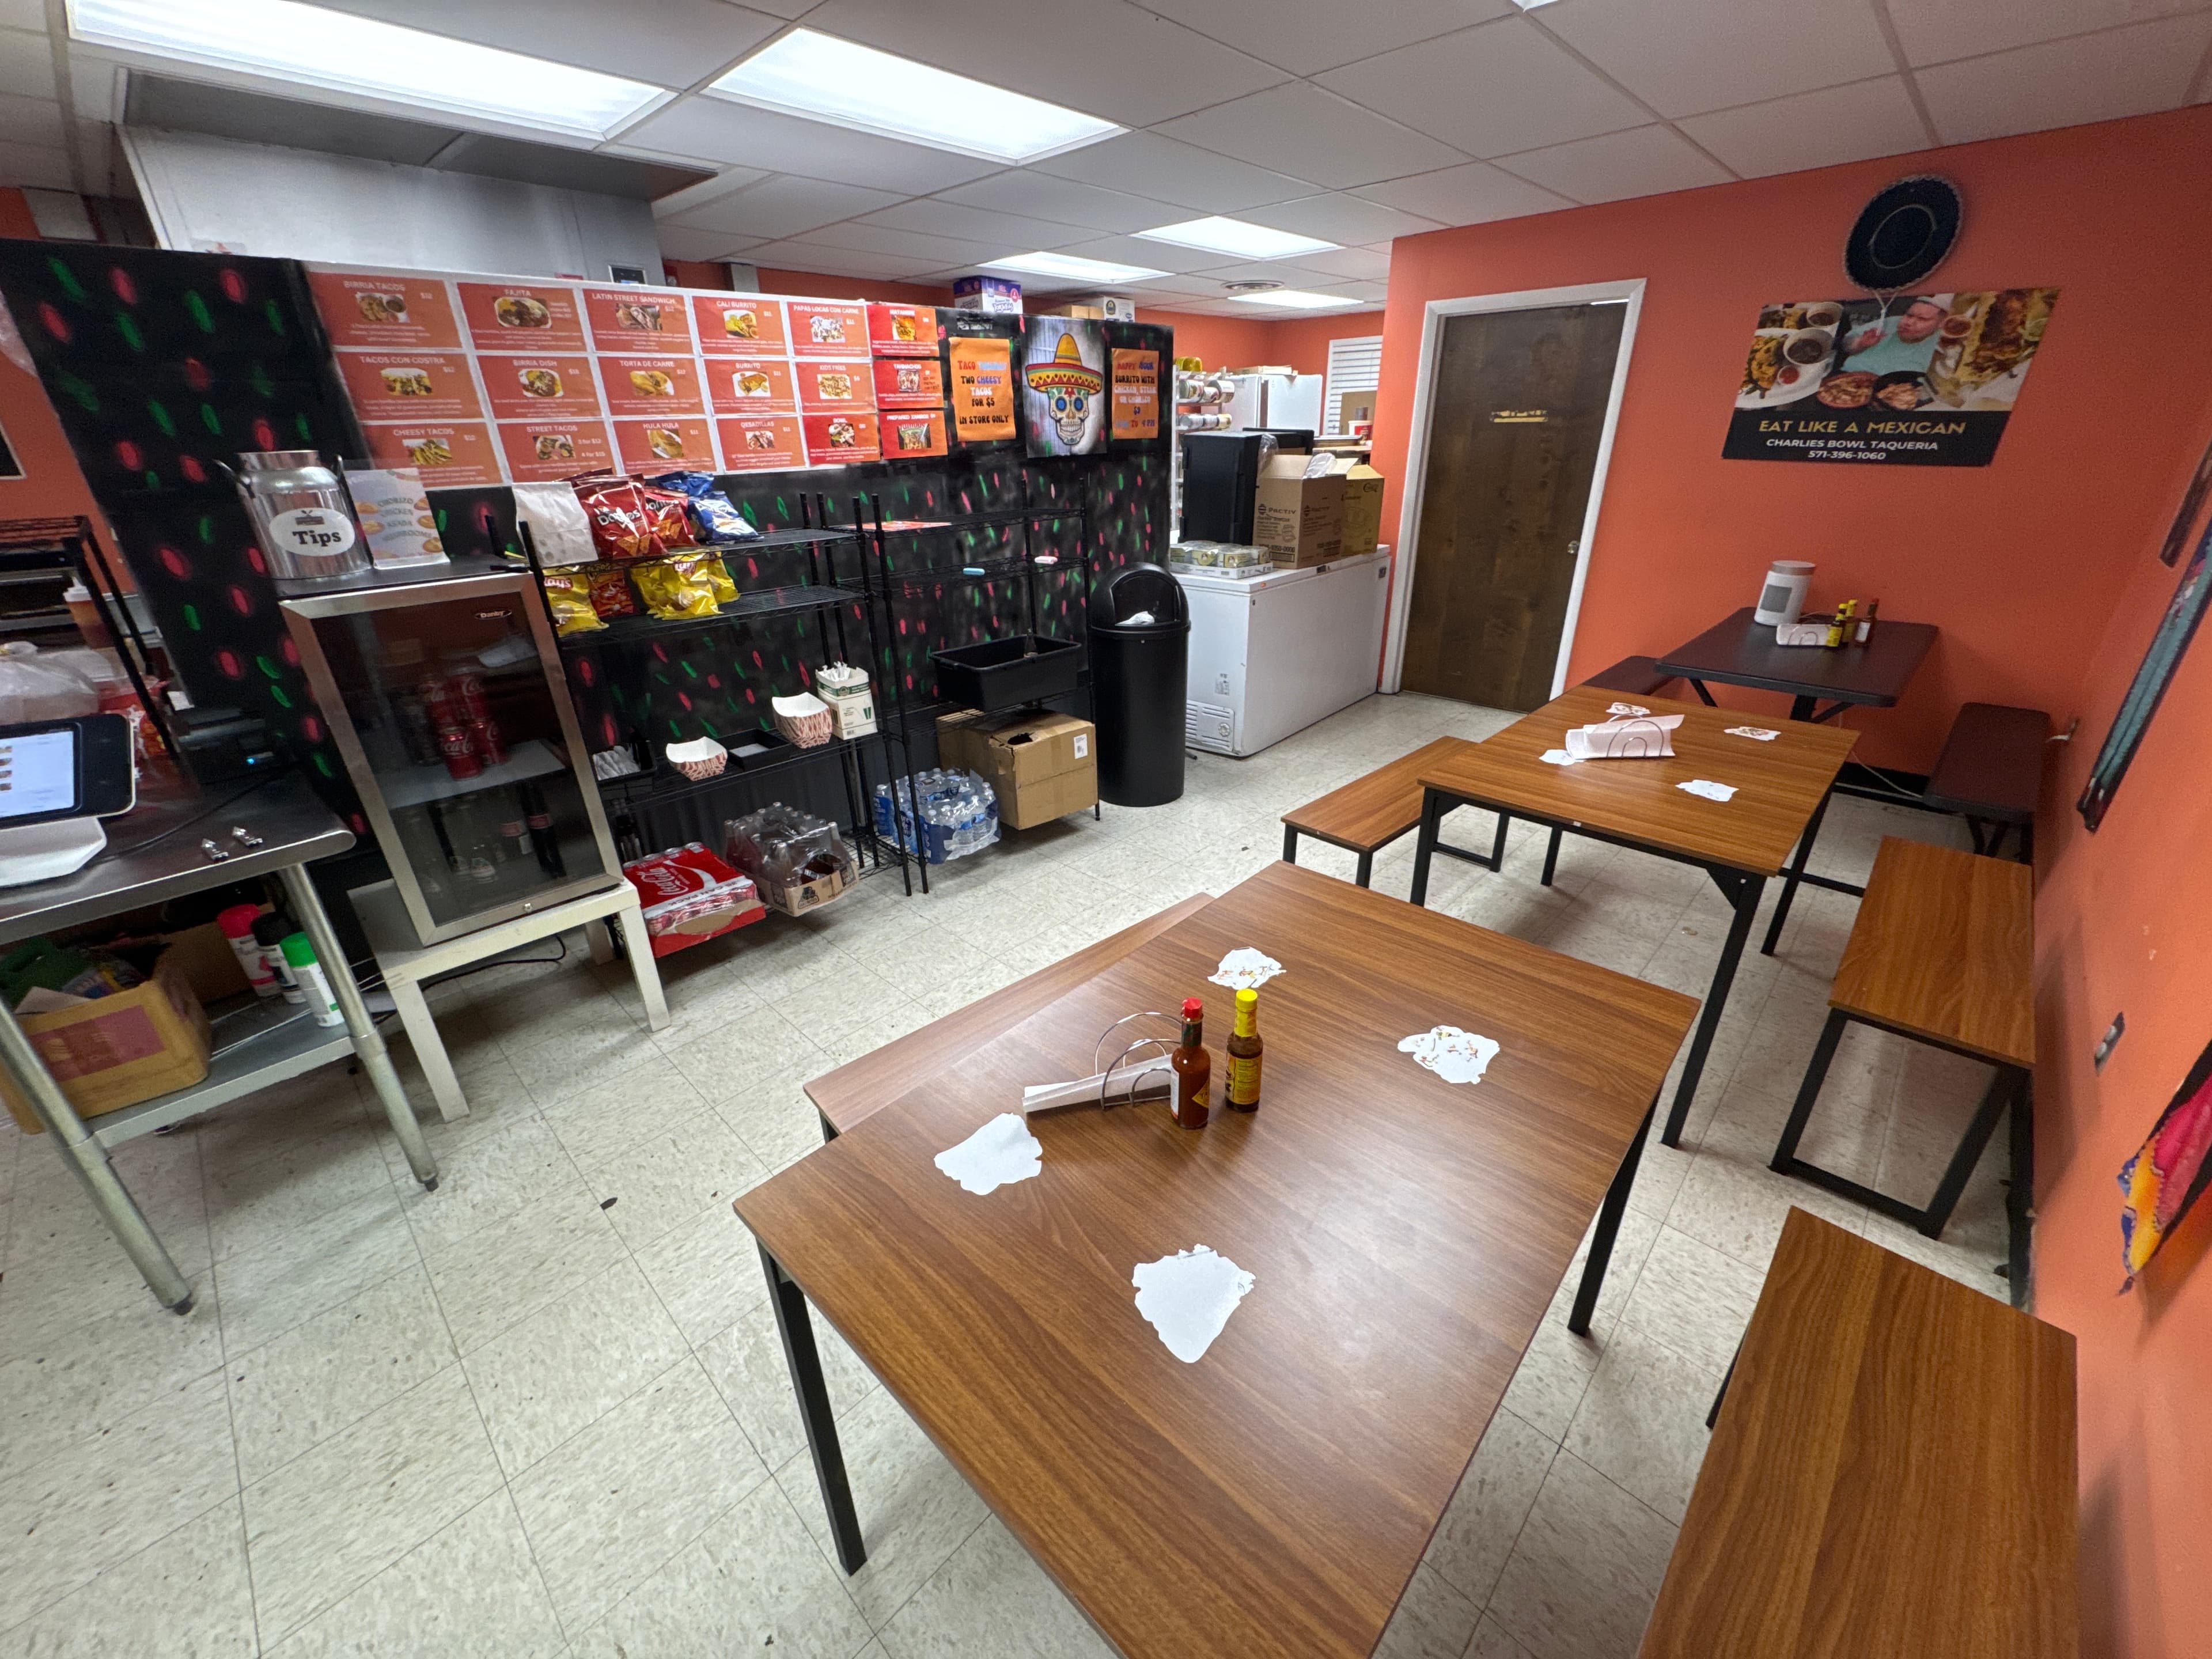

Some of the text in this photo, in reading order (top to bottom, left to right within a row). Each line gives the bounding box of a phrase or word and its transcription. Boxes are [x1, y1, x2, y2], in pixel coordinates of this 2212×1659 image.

[344, 281, 406, 292] BIRRIA TACOS
[504, 289, 531, 297] FAJITA
[732, 301, 757, 309] BURRITO
[359, 355, 446, 365] TACOS CON COSTRA
[957, 360, 976, 370] TACO
[1116, 362, 1137, 370] HAPPY
[960, 375, 1002, 385] TWO CHEESY
[1115, 374, 1155, 384] BURRITO WITH
[969, 387, 993, 396] TACOS
[972, 397, 995, 408] FOR $5
[959, 414, 1009, 425] IN STORE ONLY
[1131, 419, 1138, 428] TO
[393, 428, 426, 436] CHEESY
[527, 425, 553, 433] STREET
[1759, 420, 1966, 434] EAT LIKE A MEXICAN
[1765, 438, 1938, 451] CHARLIES BOWL TAQUERIA
[1807, 450, 1887, 460] 571-396-1060
[291, 530, 342, 547] Tips
[700, 886, 725, 896] CAN
[668, 895, 699, 906] PACK
